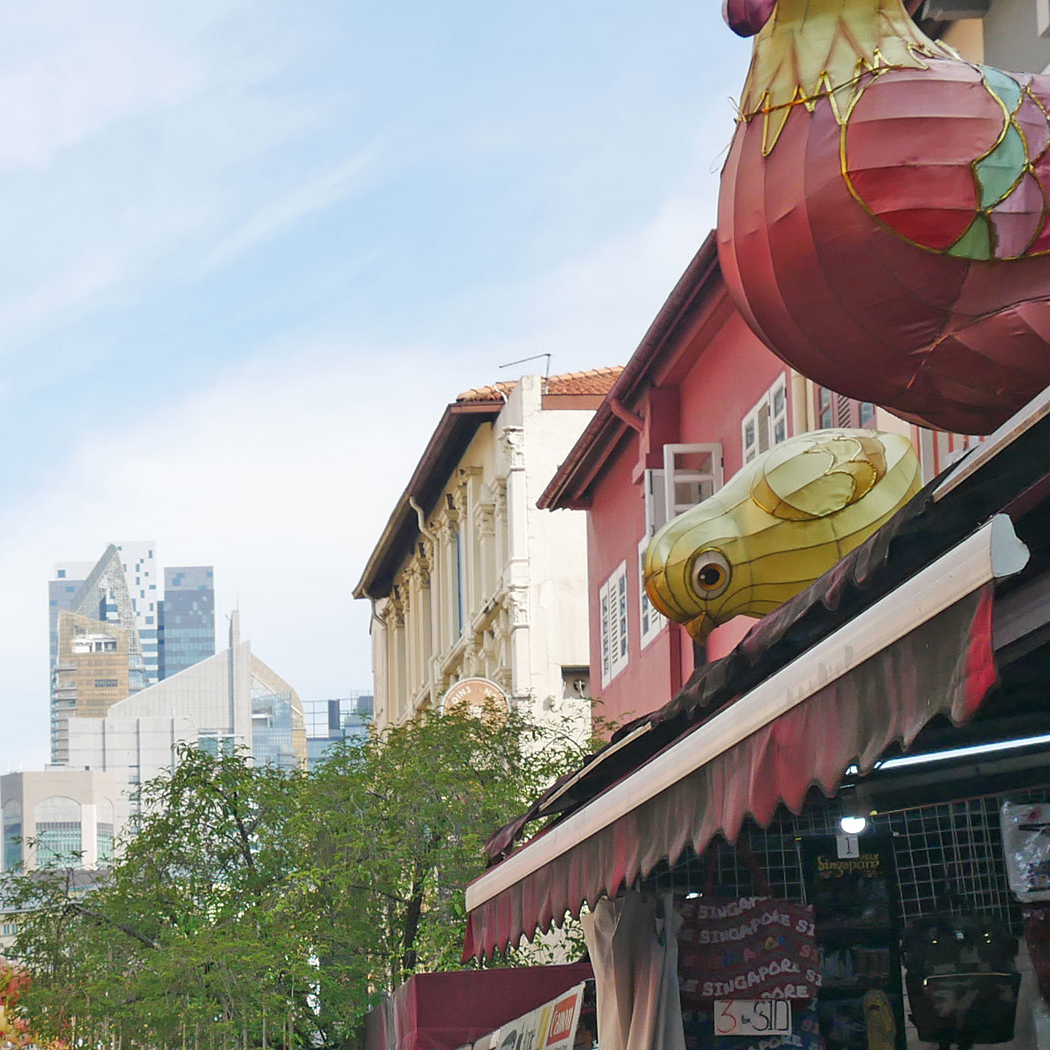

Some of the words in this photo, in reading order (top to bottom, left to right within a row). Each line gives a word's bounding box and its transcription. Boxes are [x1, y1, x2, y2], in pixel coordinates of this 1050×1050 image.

[700, 909, 791, 944] SINGAPORE
[702, 957, 801, 997] SINGAPORE
[717, 1000, 737, 1033] 3
